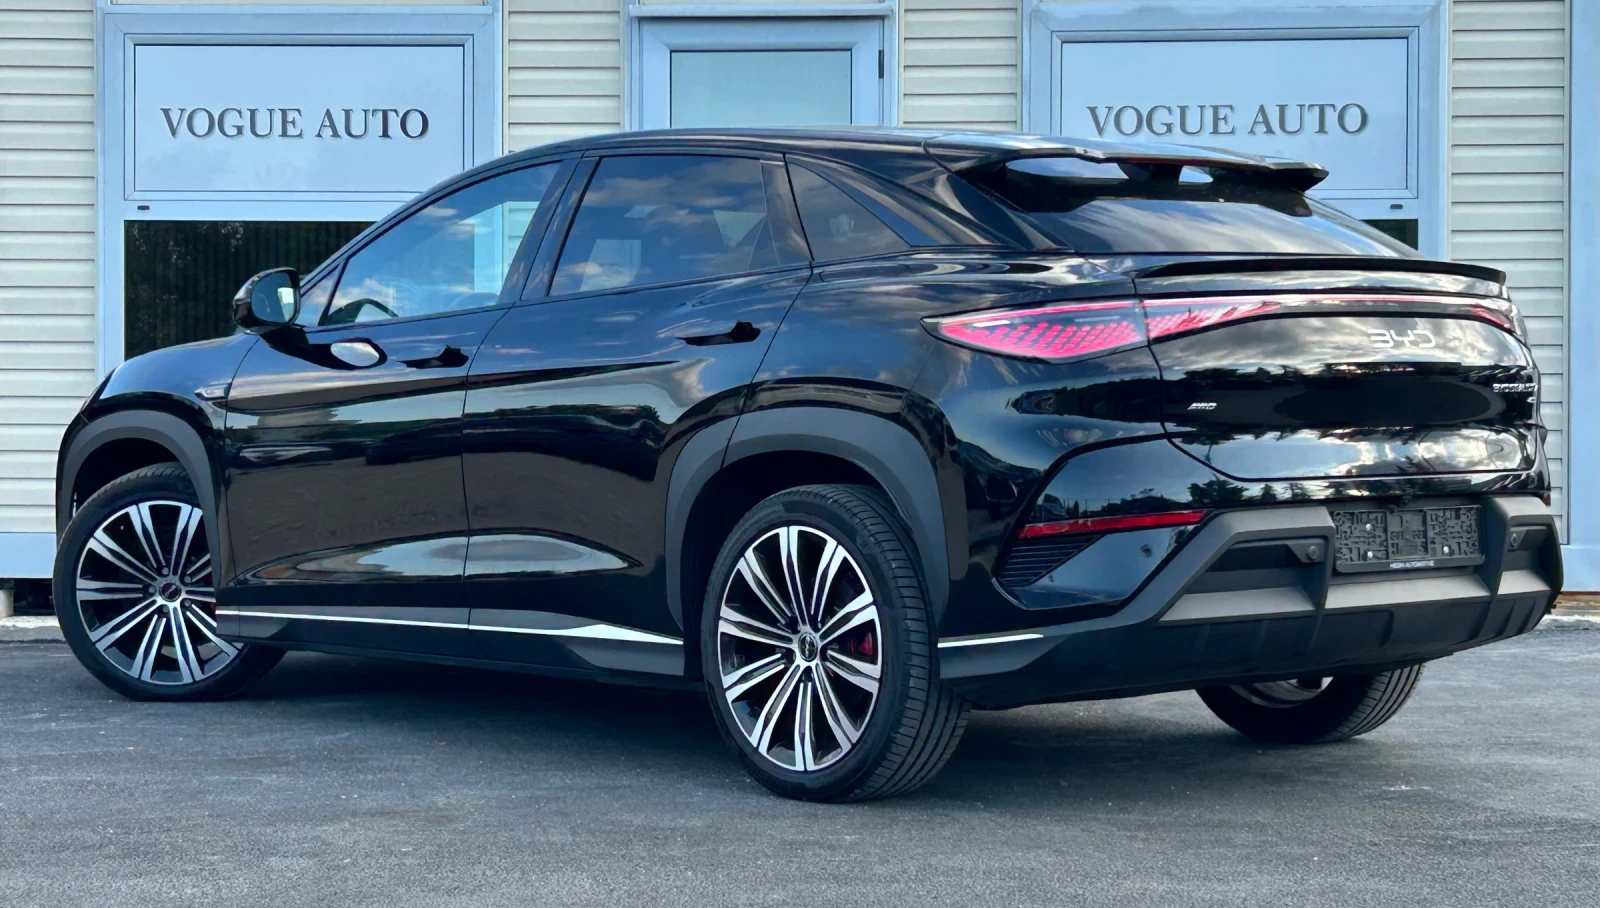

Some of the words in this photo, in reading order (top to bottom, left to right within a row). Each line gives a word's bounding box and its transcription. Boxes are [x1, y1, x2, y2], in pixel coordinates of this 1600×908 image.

[159, 107, 303, 139] VOGUE
[314, 107, 429, 139] AUTO
[1086, 104, 1236, 137] VOGUE
[1247, 103, 1369, 136] AUTO
[1367, 329, 1436, 348] BYD
